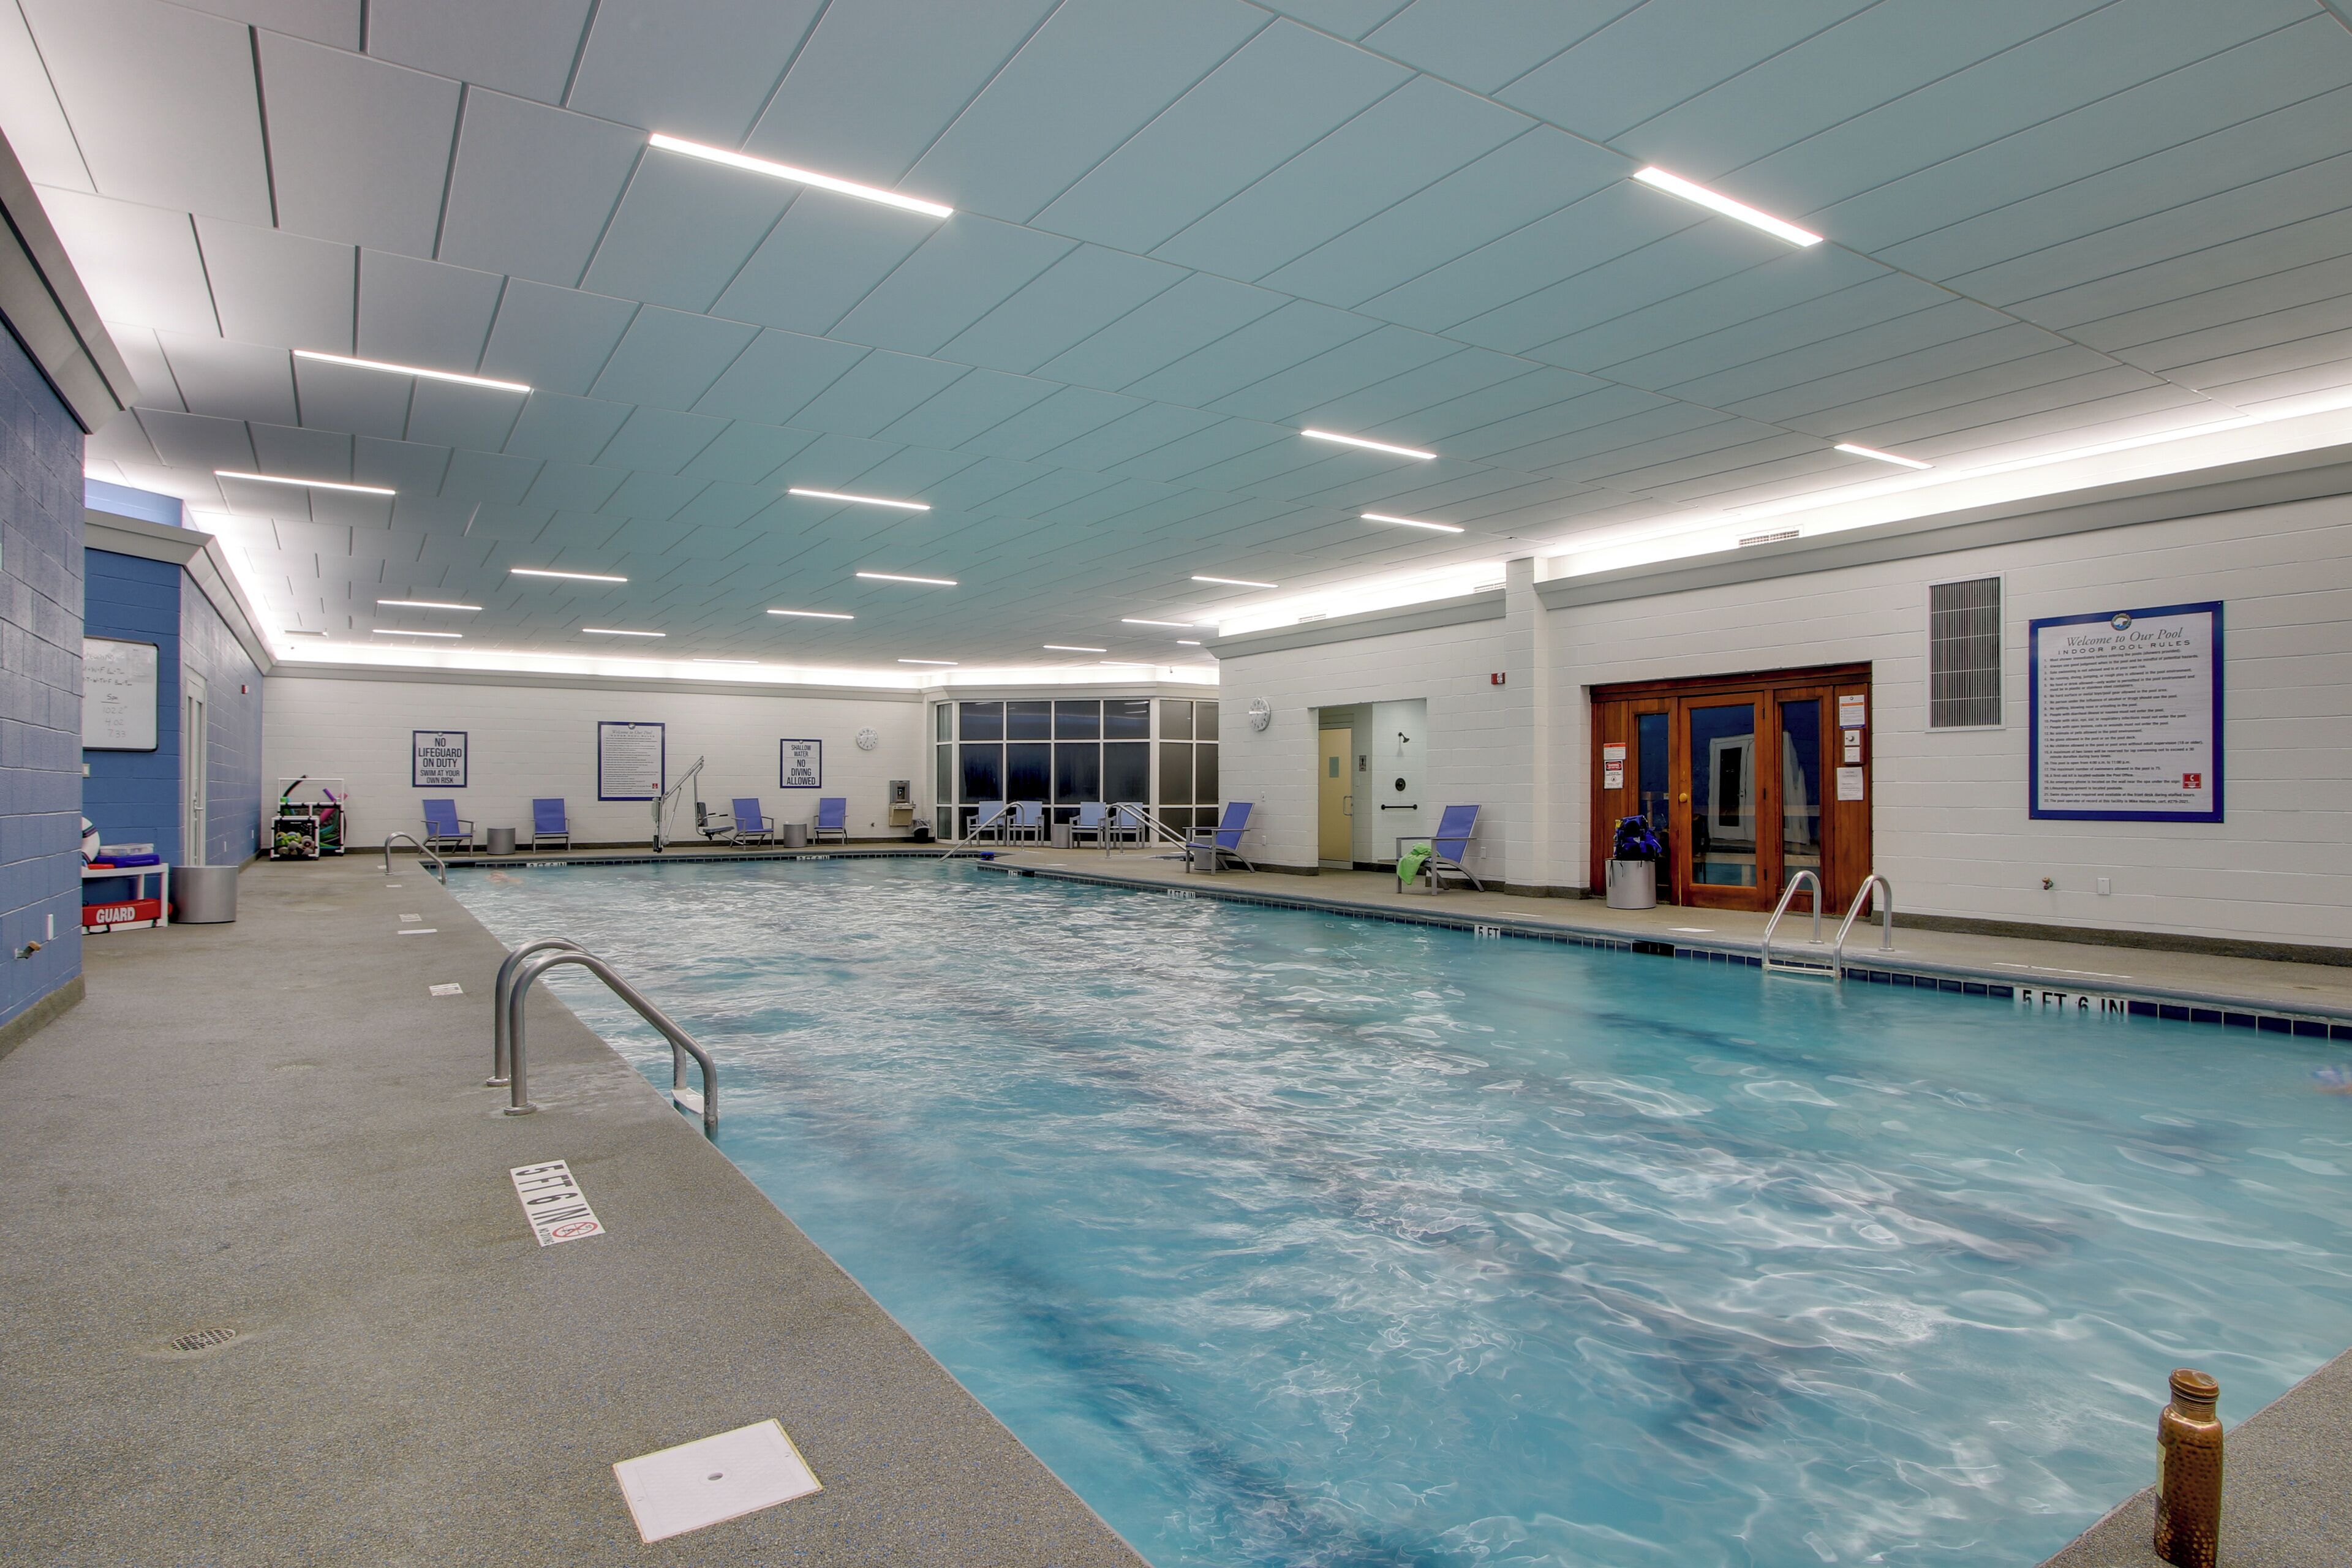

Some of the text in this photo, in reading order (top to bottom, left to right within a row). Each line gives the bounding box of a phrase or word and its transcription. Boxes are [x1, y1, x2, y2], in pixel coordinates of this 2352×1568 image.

[2067, 635, 2111, 646] Welcome
[2130, 631, 2154, 642] Our
[2157, 627, 2183, 639] Pool
[435, 737, 446, 747] NO
[418, 747, 462, 757] LIFEGUARD
[423, 758, 458, 767] ON DUTY
[96, 907, 135, 923] GUARD
[1488, 927, 1499, 939] FT
[2022, 989, 2124, 1013] 5 FT 6 IN
[515, 1164, 590, 1226] 5 FT 6 IN
